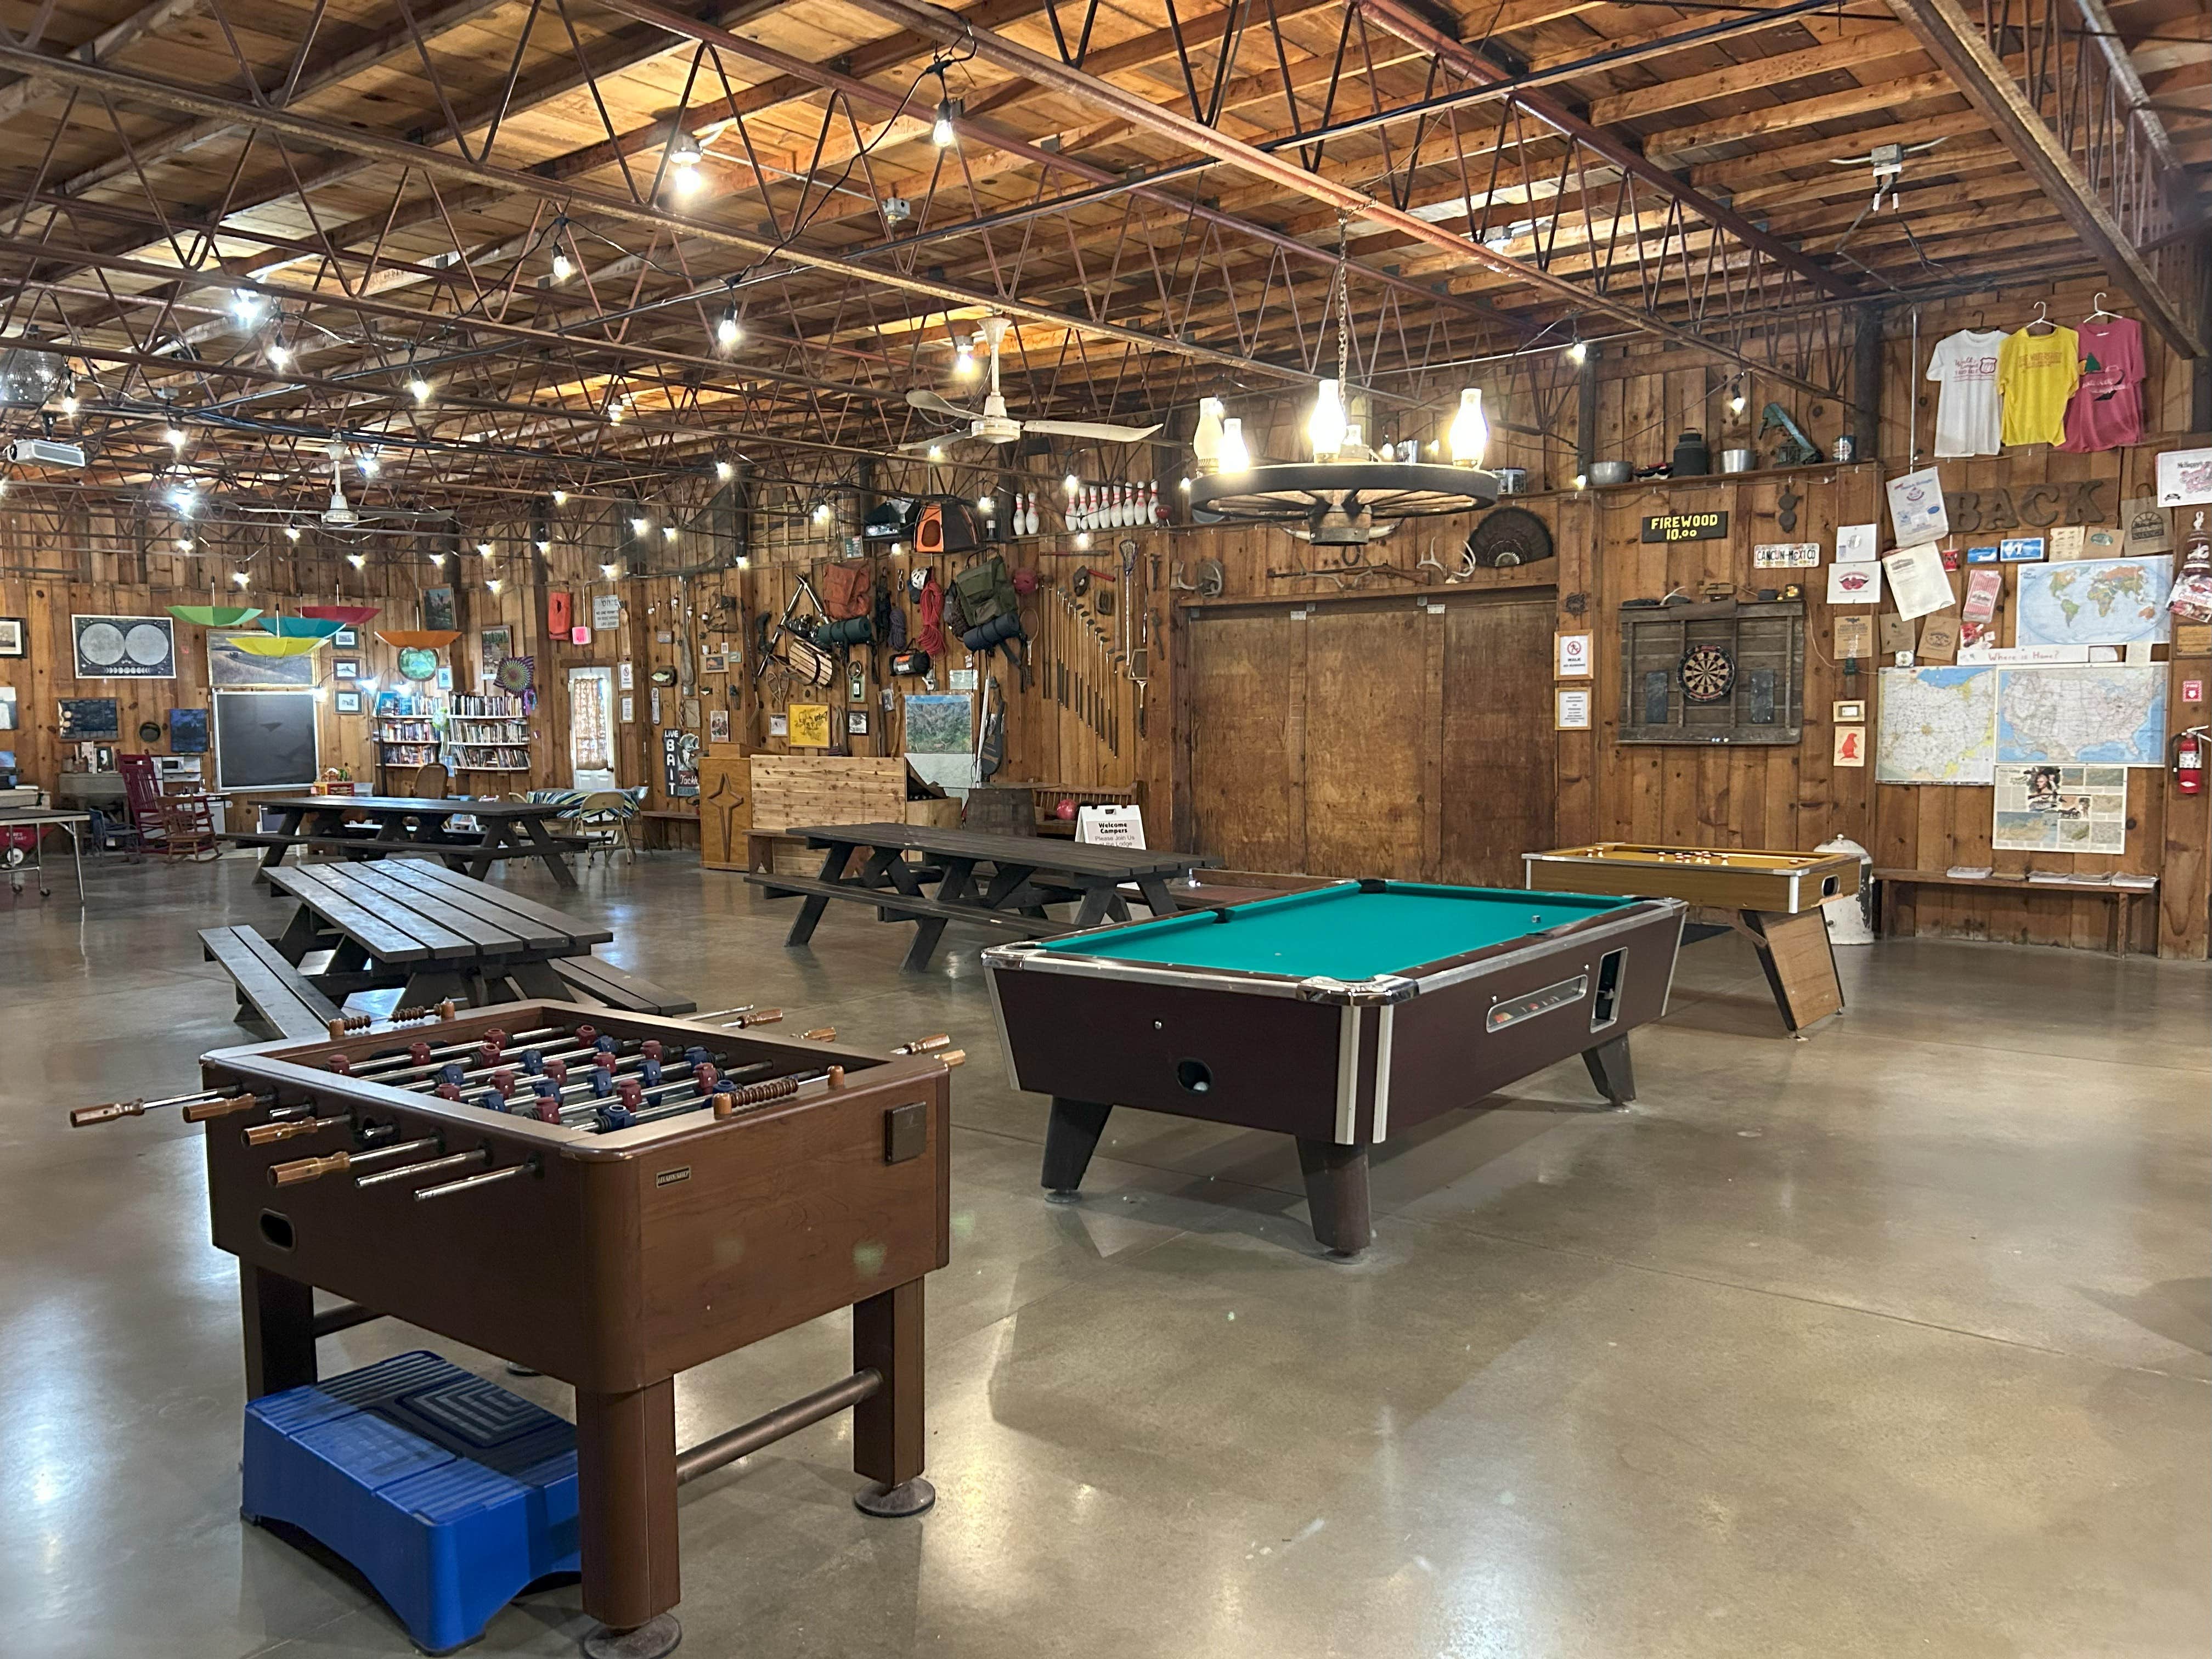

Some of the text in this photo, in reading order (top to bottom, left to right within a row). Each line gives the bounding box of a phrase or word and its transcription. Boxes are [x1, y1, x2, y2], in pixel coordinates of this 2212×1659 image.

[1944, 481, 2105, 533] BACK
[1651, 514, 1718, 530] FIREWOOD
[1666, 528, 1697, 540] 10.00
[1988, 652, 2016, 661] Where
[2033, 650, 2059, 659] Home?
[664, 729, 679, 738] LIVE
[666, 738, 676, 795] BAIT
